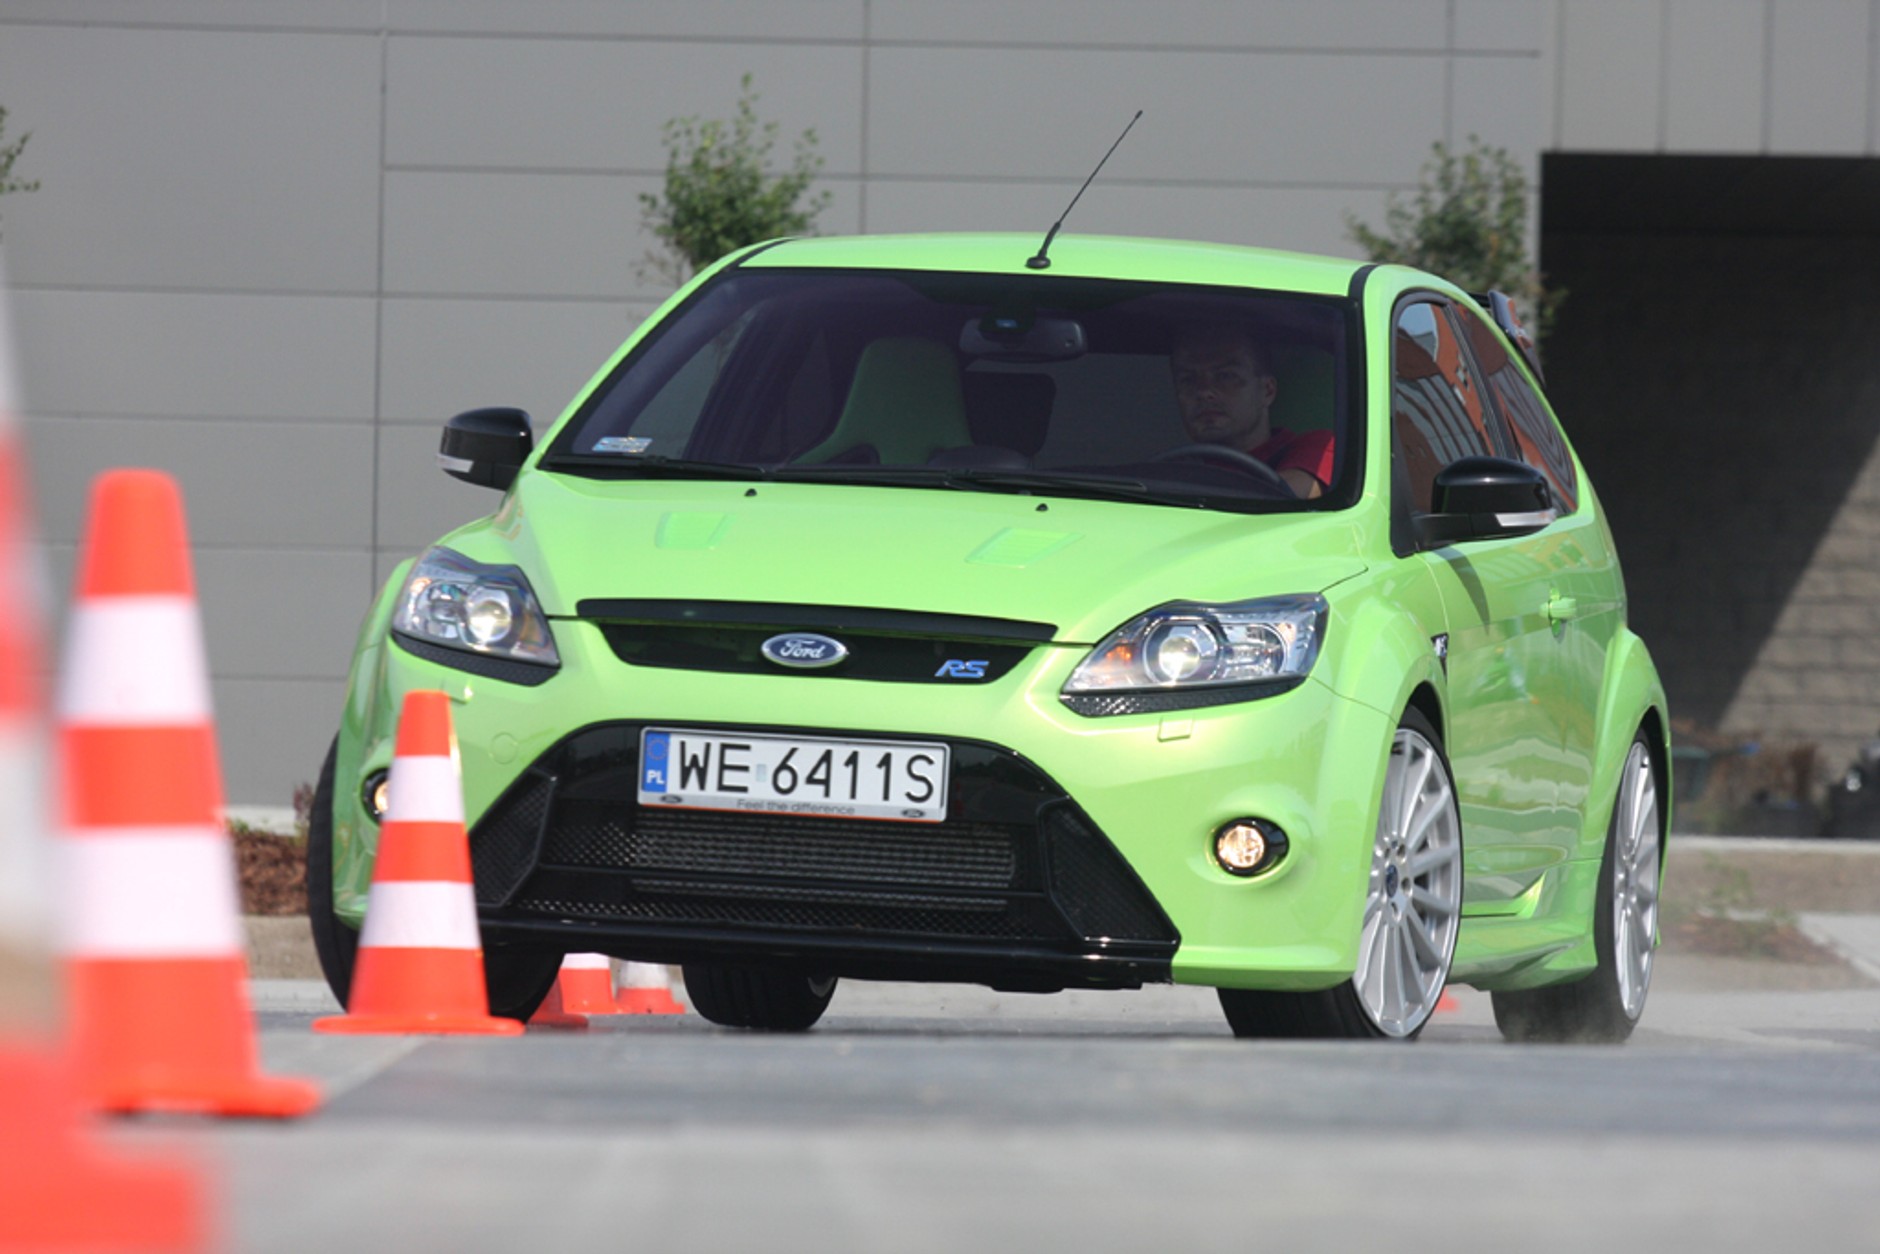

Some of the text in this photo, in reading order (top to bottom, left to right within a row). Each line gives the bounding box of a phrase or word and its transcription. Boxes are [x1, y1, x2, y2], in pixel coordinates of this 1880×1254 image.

[779, 640, 826, 659] Ford
[934, 659, 990, 678] RS
[646, 769, 665, 785] PL
[680, 740, 935, 803] WE 6411S
[737, 799, 855, 815] Feel the difference
